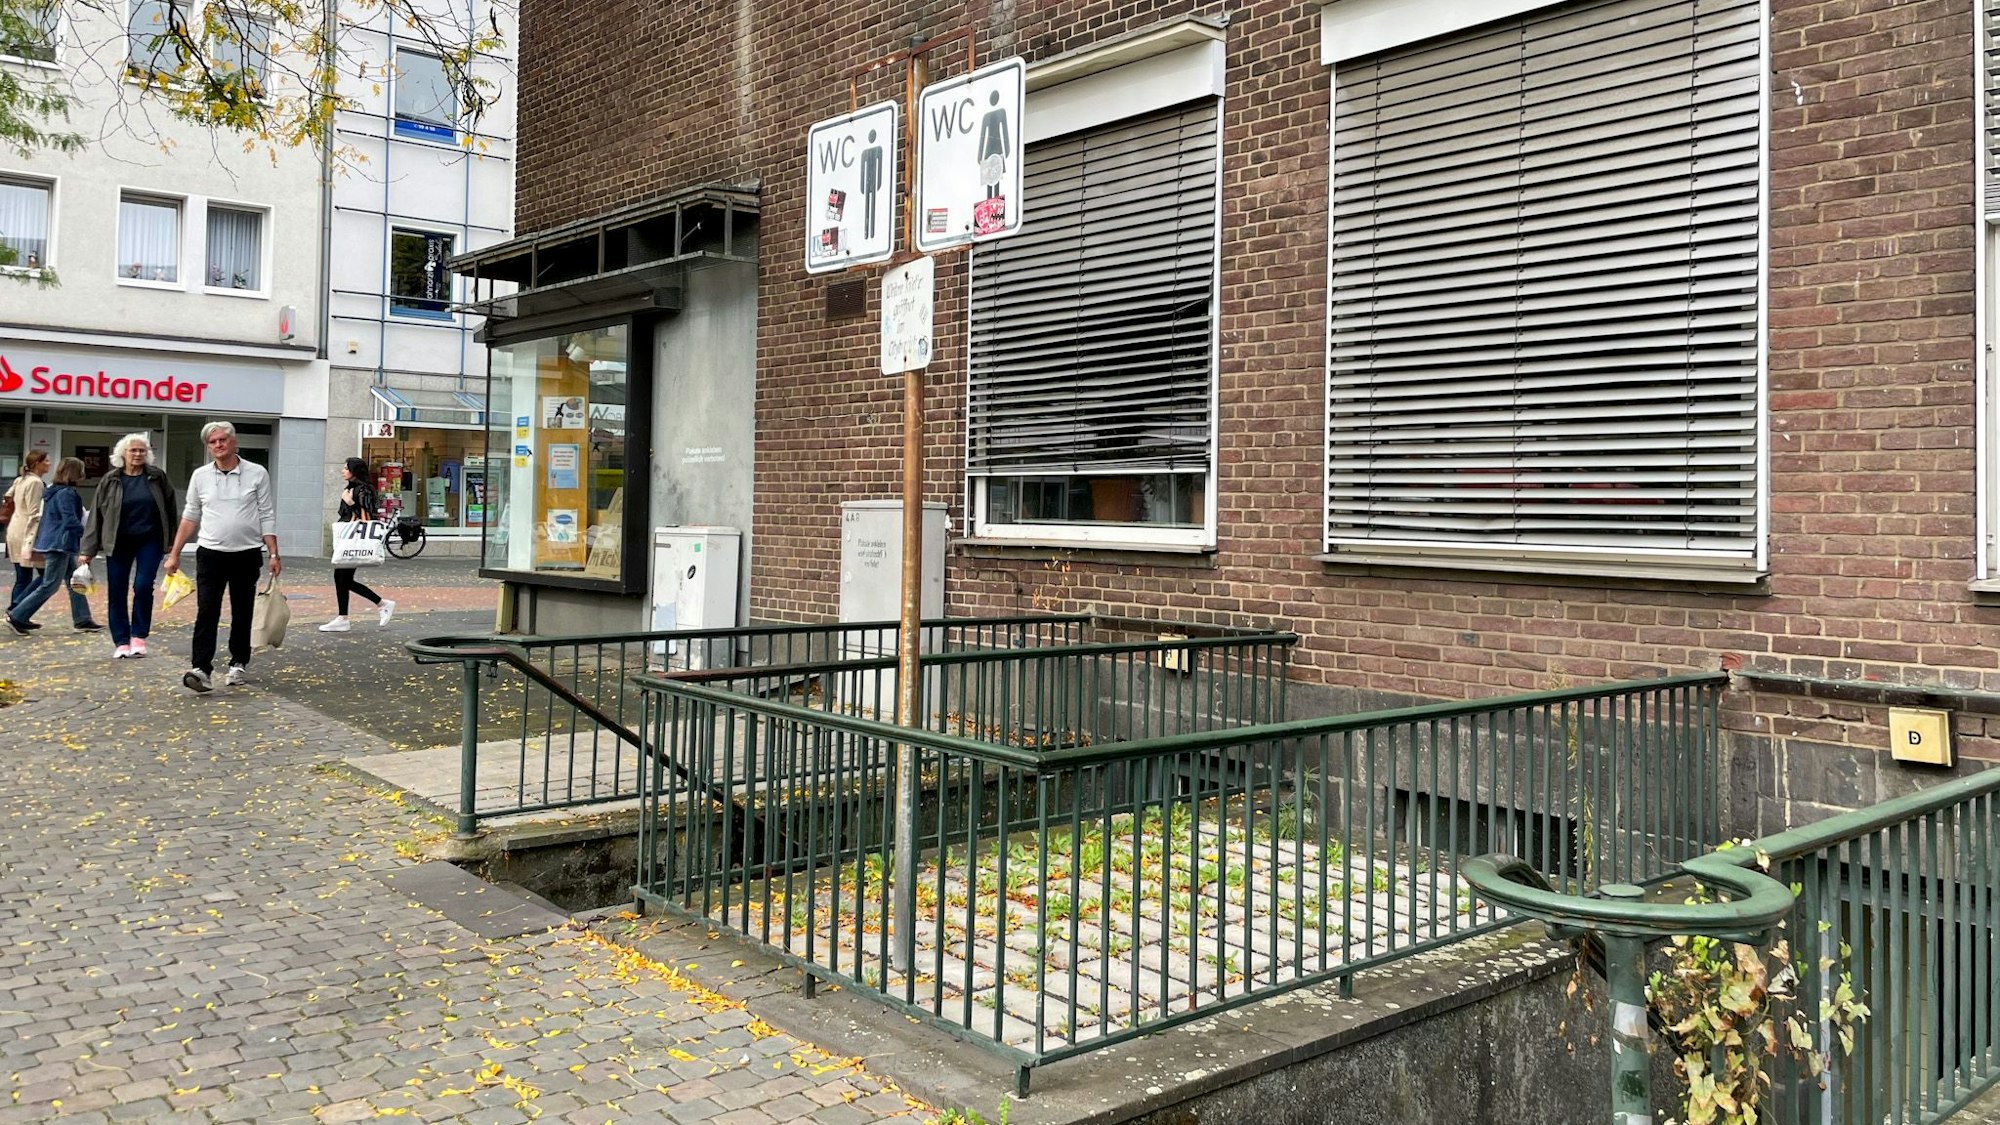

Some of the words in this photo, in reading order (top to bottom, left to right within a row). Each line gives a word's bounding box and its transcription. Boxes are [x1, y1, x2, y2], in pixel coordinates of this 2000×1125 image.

[931, 97, 975, 142] WC
[818, 134, 855, 174] WC
[30, 366, 209, 403] Santander
[342, 549, 374, 557] ACTION
[1908, 730, 1922, 745] D
